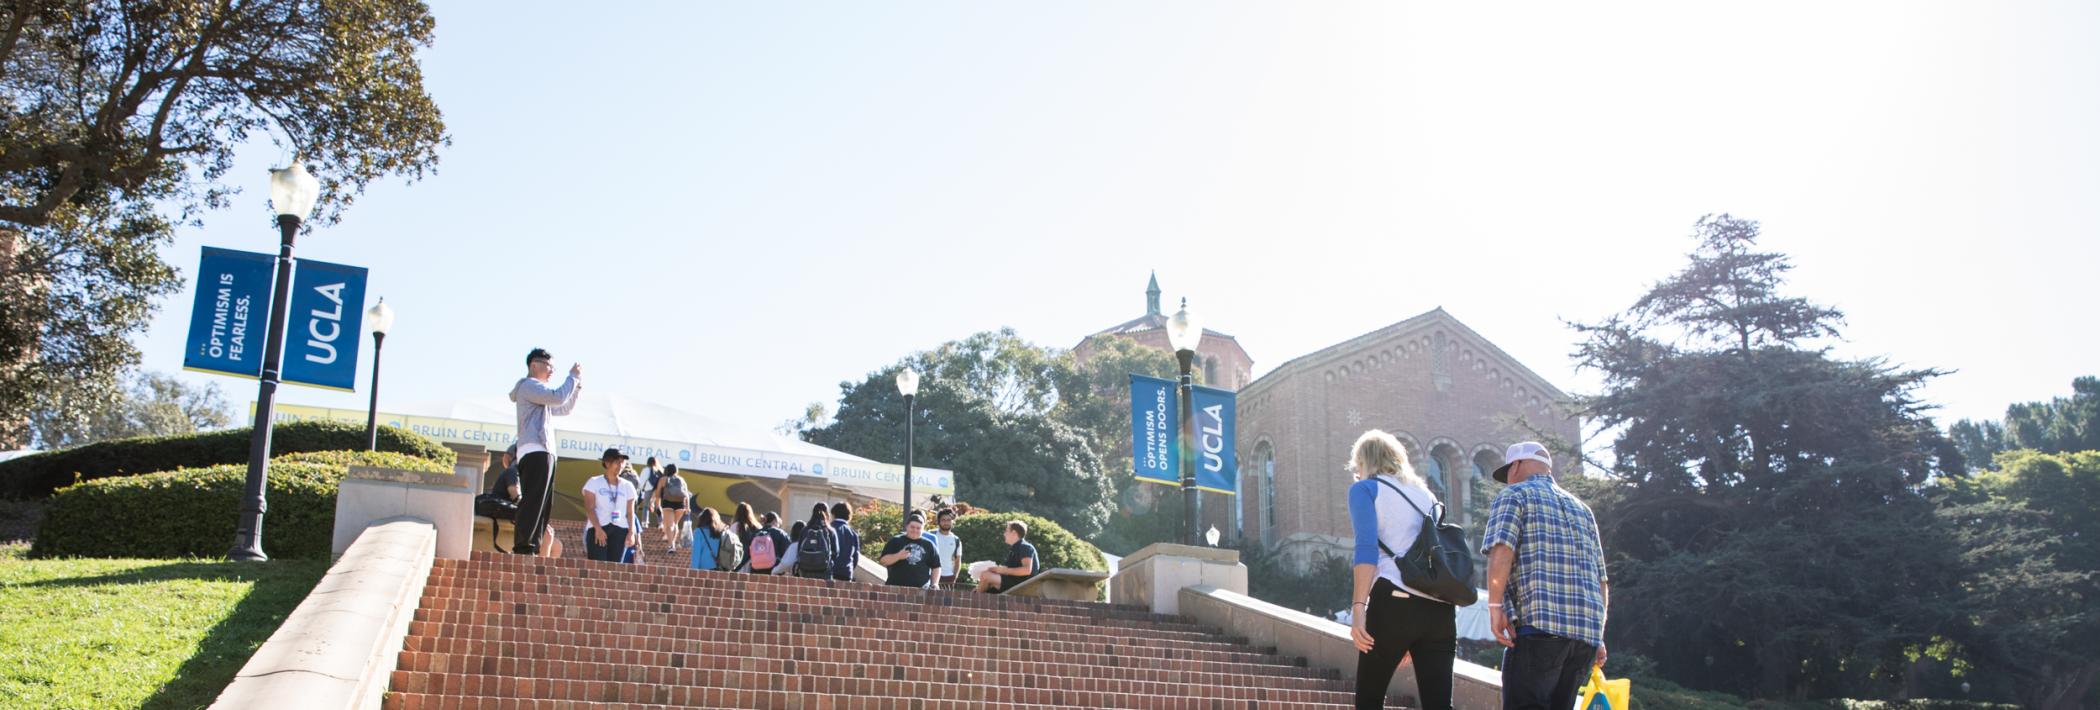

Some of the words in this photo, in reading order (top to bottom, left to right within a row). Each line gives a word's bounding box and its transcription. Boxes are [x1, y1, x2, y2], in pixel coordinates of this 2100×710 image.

[220, 273, 234, 285] IS
[209, 288, 232, 358] OPTIMISM
[228, 295, 251, 361] FEARLESS.
[305, 282, 346, 365] UCLA
[1157, 386, 1167, 430] DOORS.
[412, 424, 457, 439] BRUIN
[560, 438, 603, 452] BRUIN
[1146, 410, 1156, 468] OPTIMISM
[1158, 432, 1168, 470] OPENS
[1203, 404, 1222, 472] UCLA
[700, 452, 741, 466] BRUIN
[746, 457, 805, 473] CENTRAL
[832, 466, 871, 479] BRUIN
